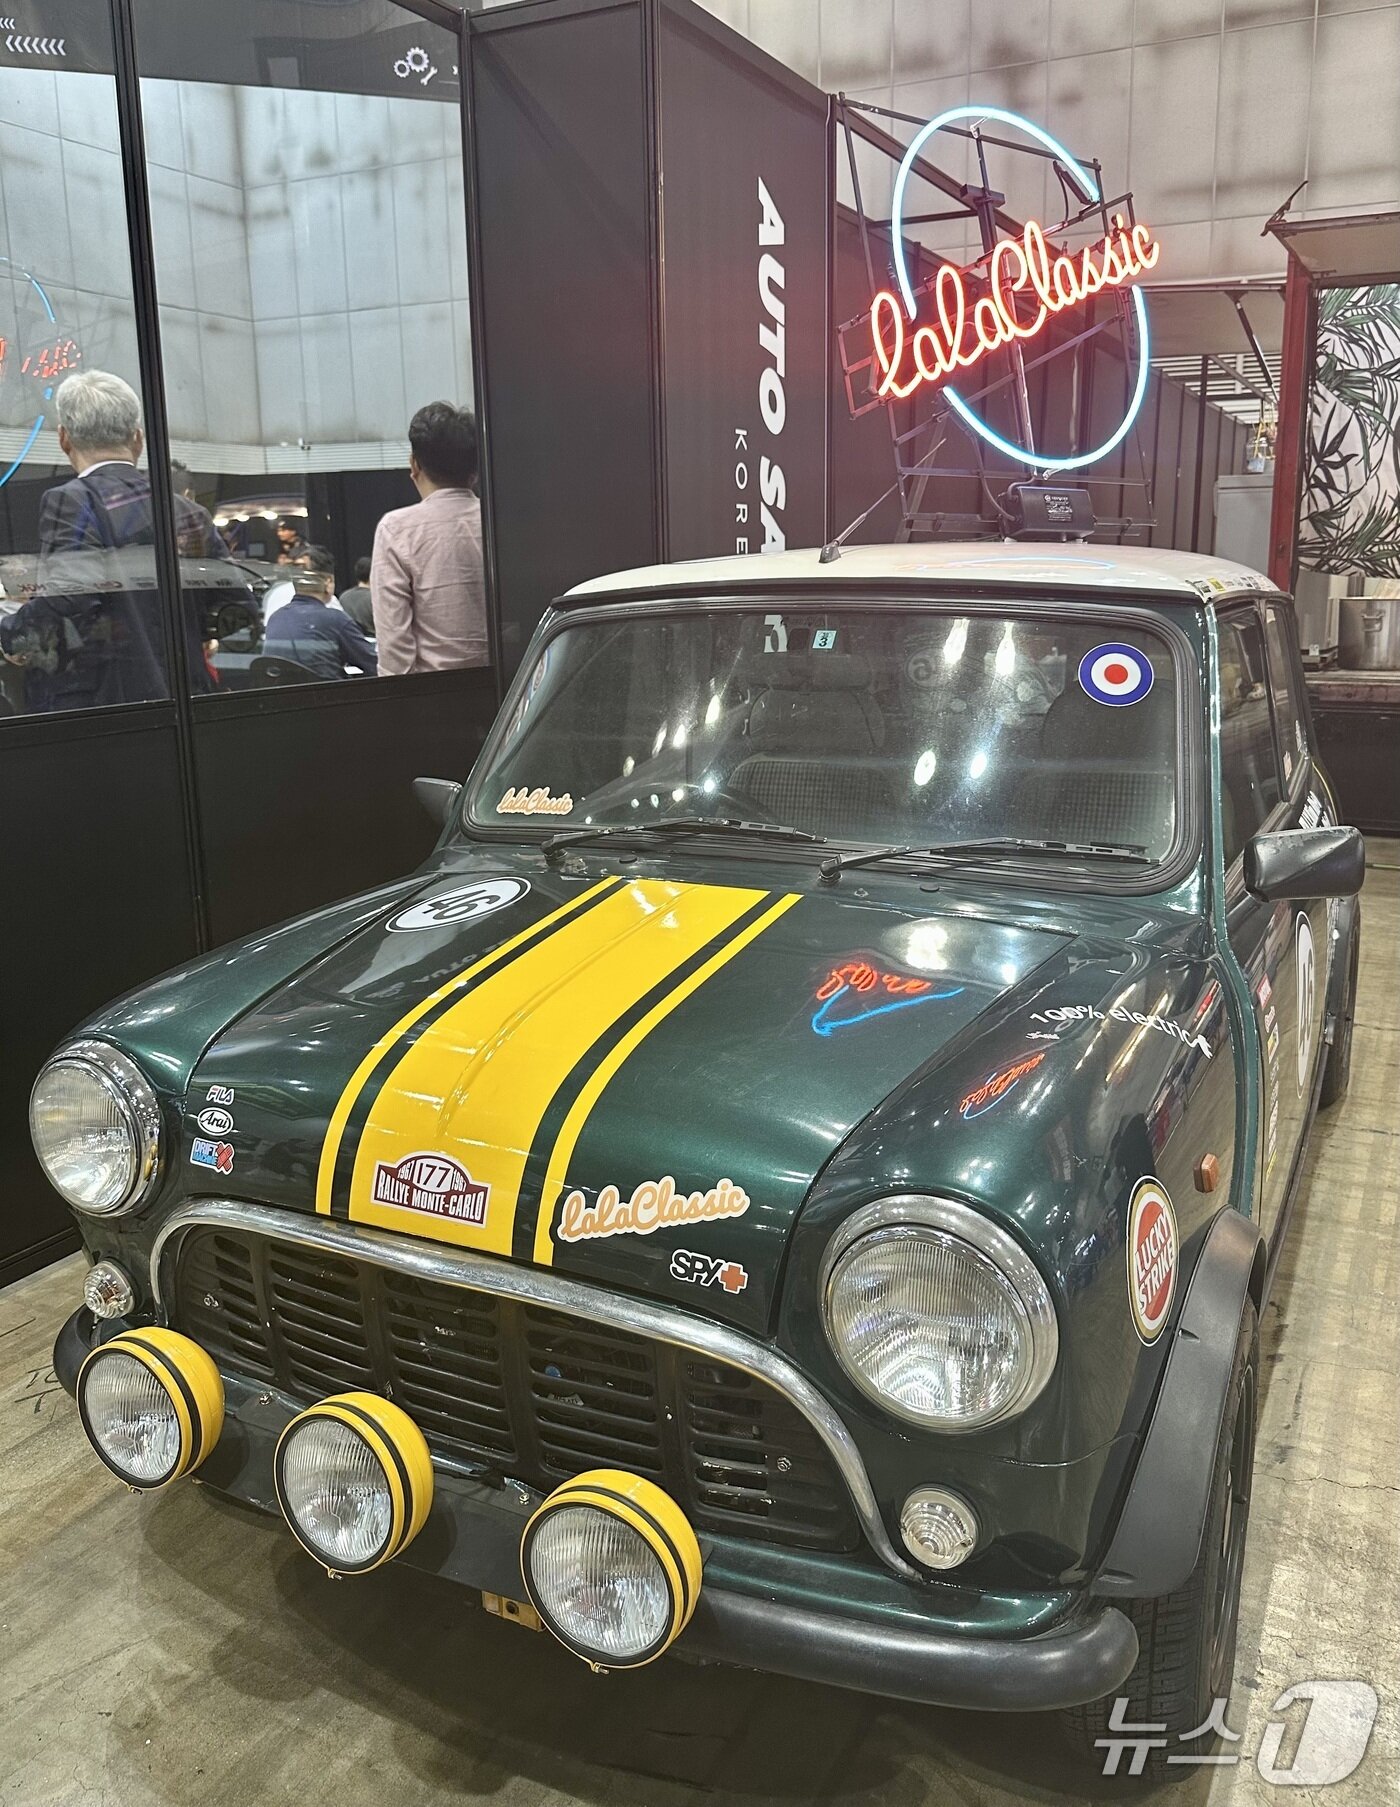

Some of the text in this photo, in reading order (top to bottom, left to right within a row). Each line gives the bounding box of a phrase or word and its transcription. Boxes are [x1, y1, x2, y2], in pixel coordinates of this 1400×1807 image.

[758, 176, 786, 435] AUTO
[871, 213, 1160, 398] lalaClassic
[735, 428, 748, 554] KORE
[422, 889, 501, 920] 46
[1029, 1004, 1105, 1023] 100%
[201, 1111, 228, 1129] Arai
[208, 1086, 233, 1104] FILA
[376, 1169, 485, 1221] RALLYE MONTE-CARLO
[416, 1162, 451, 1189] 177
[561, 1180, 746, 1238] lalaClassic
[671, 1252, 723, 1286] SPY
[1134, 1204, 1171, 1282] LUCKY
[1138, 1235, 1175, 1316] STRIKE
